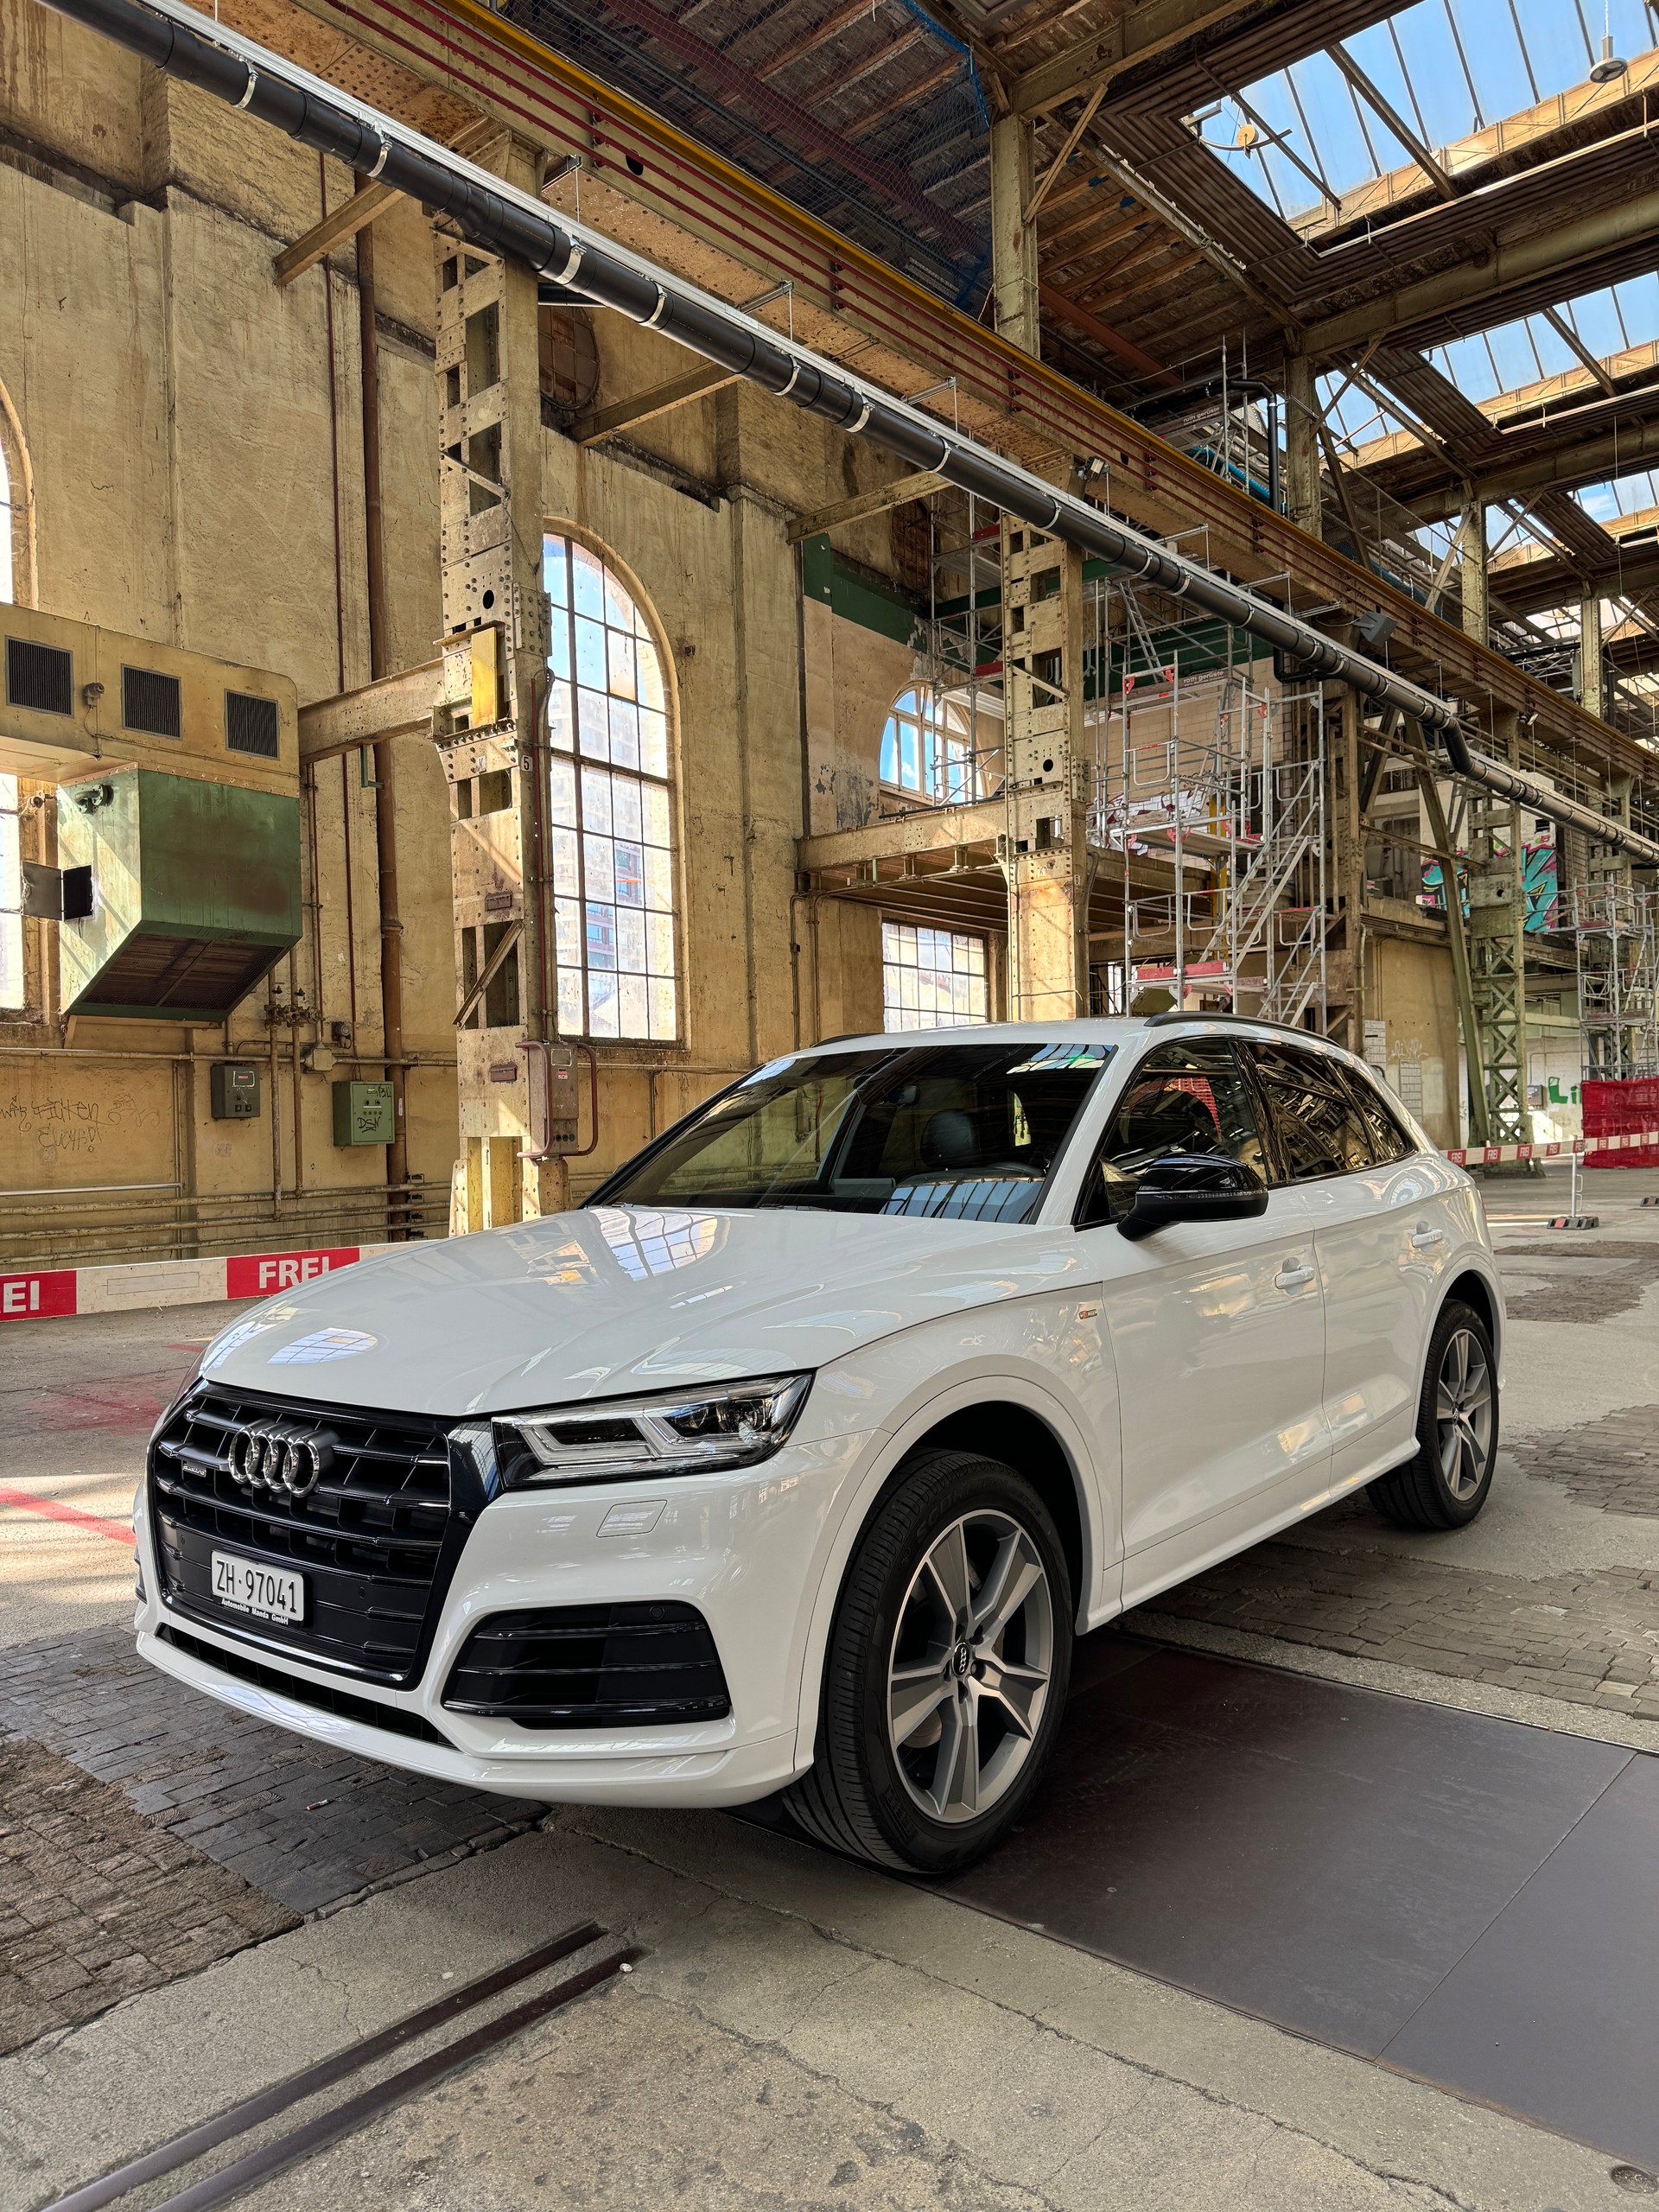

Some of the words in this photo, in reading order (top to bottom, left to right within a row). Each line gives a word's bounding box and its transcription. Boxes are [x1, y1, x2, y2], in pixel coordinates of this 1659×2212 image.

[524, 756, 530, 770] 5
[1076, 874, 1079, 885] 6
[1548, 1076, 1582, 1104] Li
[1452, 1152, 1463, 1163] FREI
[1488, 1149, 1498, 1160] FREI
[1520, 1147, 1529, 1157] FREI
[0, 1281, 40, 1313] EI
[221, 1598, 250, 1613] Automobile
[251, 1608, 270, 1619] Manda
[271, 1613, 289, 1624] GmbH
